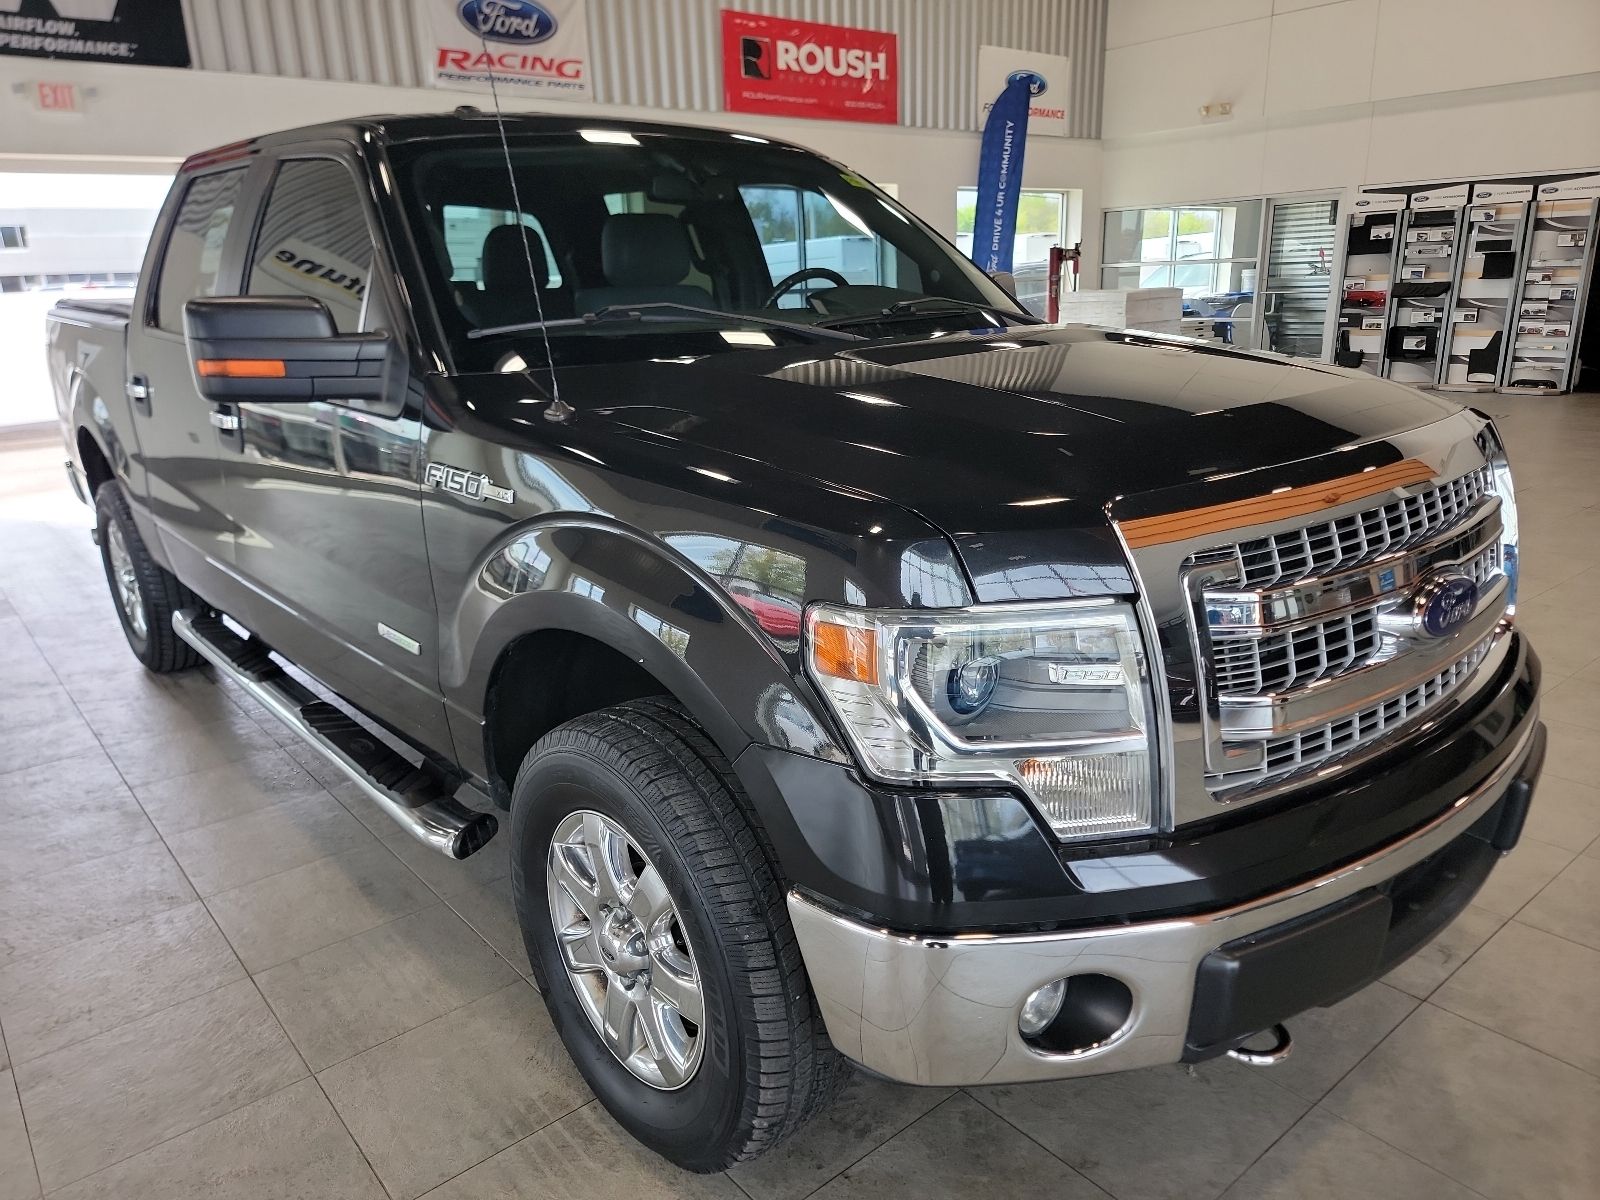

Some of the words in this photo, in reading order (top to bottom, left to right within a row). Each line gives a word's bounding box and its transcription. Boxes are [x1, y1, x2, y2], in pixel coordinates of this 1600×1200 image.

[481, 0, 540, 37] Ford
[437, 48, 584, 79] RACING
[776, 40, 887, 80] ROUSH
[38, 82, 74, 110] EXIT
[998, 120, 1015, 190] COMMUNITY
[996, 191, 1006, 207] UR
[991, 218, 1003, 251] DRIVE
[1440, 587, 1473, 628] Ford
